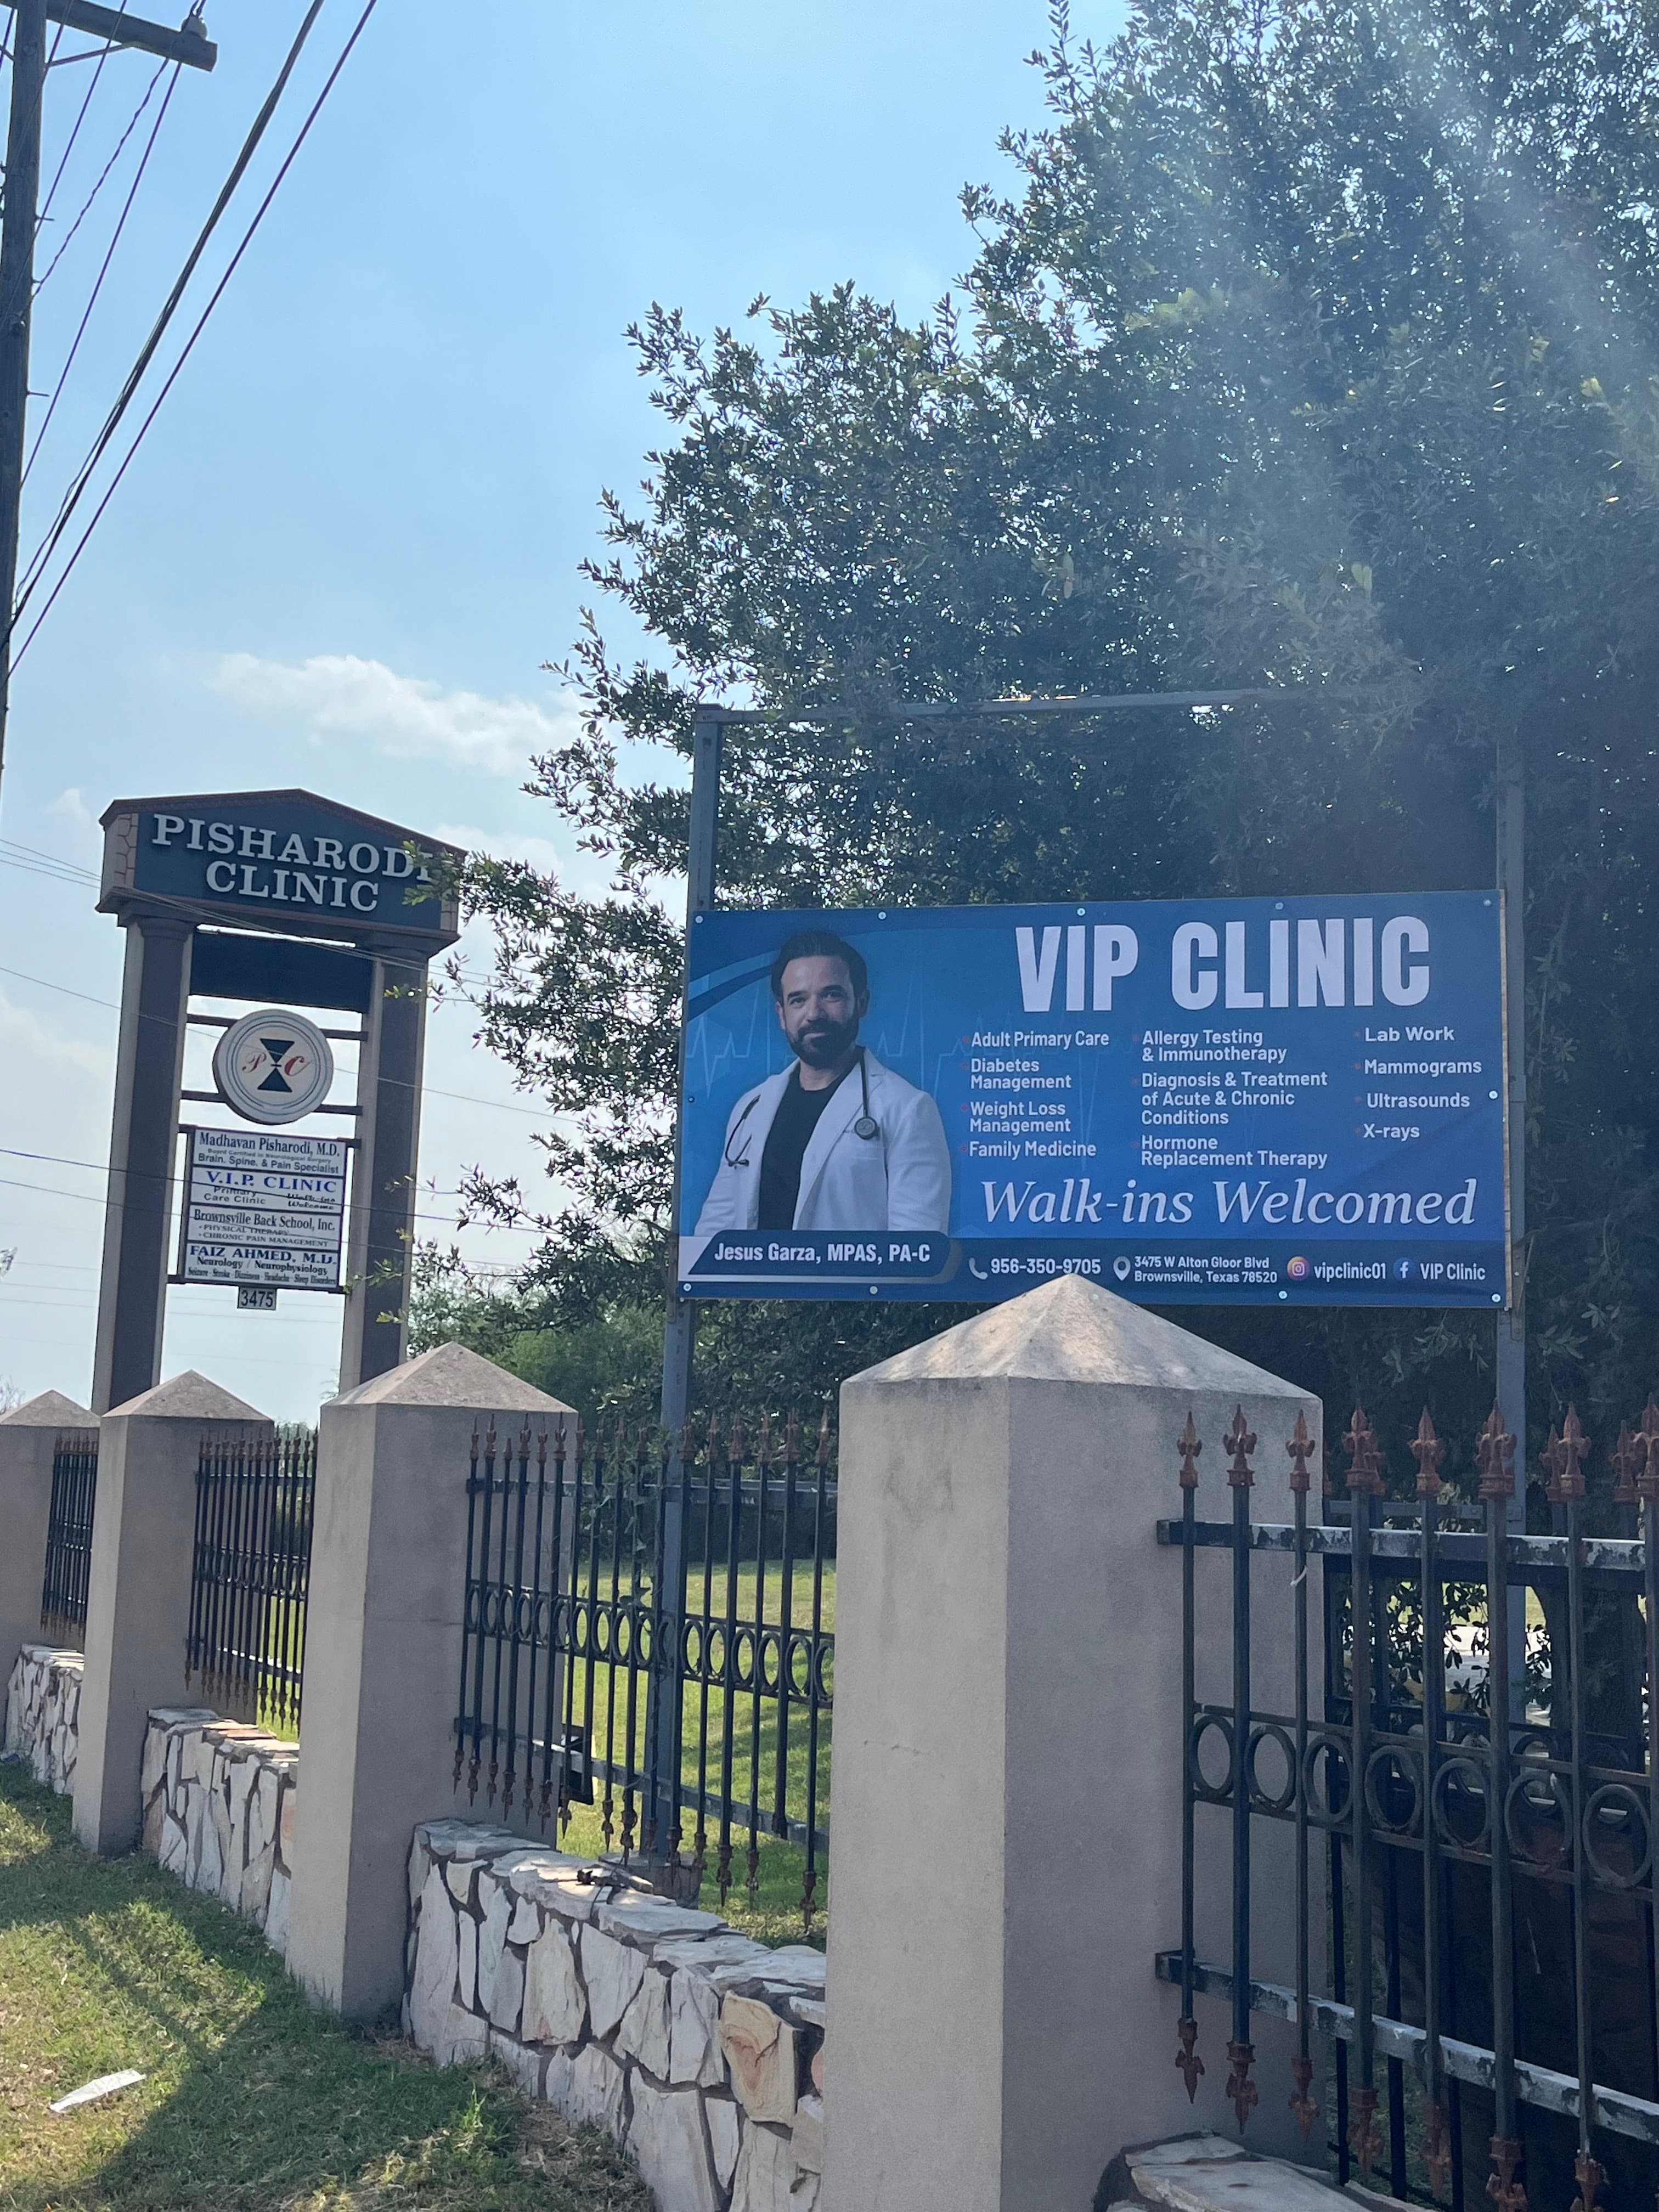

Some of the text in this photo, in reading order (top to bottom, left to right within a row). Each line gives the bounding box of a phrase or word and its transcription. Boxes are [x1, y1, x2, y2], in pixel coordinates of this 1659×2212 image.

[152, 814, 435, 883] PISHARODI
[206, 861, 379, 911] CLINIC
[1015, 916, 1429, 1012] VIP CLINIC
[971, 1030, 1109, 1049] Adult Primary Care
[1142, 1029, 1263, 1048] Allergy Testing
[1365, 1026, 1454, 1042] Lab Work
[1142, 1046, 1287, 1064] & Immunotherapy
[970, 1058, 1040, 1073] Diabetes
[1364, 1059, 1482, 1077] Mammograms
[970, 1075, 1071, 1092] Management
[1142, 1071, 1328, 1091] Diagnosis & Treatment
[1142, 1090, 1295, 1106] of Acute & Chronic
[1367, 1092, 1470, 1108] Ultrasounds
[970, 1101, 1065, 1119] Weight Loss
[1141, 1109, 1229, 1125] Conditions
[969, 1118, 1071, 1136] Management
[1363, 1123, 1420, 1142] X-rays
[199, 1132, 340, 1156] Madhavan Pisharodi, M.D.
[969, 1140, 1097, 1160] Family Medicine
[1141, 1135, 1218, 1150] Hormone
[261, 1159, 268, 1167] &
[271, 1160, 291, 1170] Pain
[294, 1161, 339, 1174] Specialist
[1141, 1150, 1328, 1169] Replacement Therapy
[206, 1170, 337, 1193] V.I.P. CLINIC
[204, 1193, 266, 1205] Care Clinic
[981, 1177, 1477, 1226] Walk-ins Welcomed
[194, 1209, 335, 1231] Brownsville Back School, Inc.
[203, 1232, 244, 1240] CHRONIC
[269, 1237, 329, 1247] MANAGEMENT
[190, 1245, 225, 1257] FAIZ
[714, 1243, 930, 1265] Jesus Garza, MPAS, PA-C
[198, 1256, 243, 1268] Neurology
[255, 1260, 328, 1276] Neurophysiology
[990, 1258, 1102, 1274] 956-350-9705
[1134, 1256, 1269, 1269] 3475 W Alton Gloor Blvd
[1134, 1271, 1278, 1283] Brownsville, Texas 78520
[1313, 1262, 1386, 1283] vipclinic01
[1419, 1263, 1486, 1281] VIP Clinic
[240, 1290, 274, 1307] 3475
